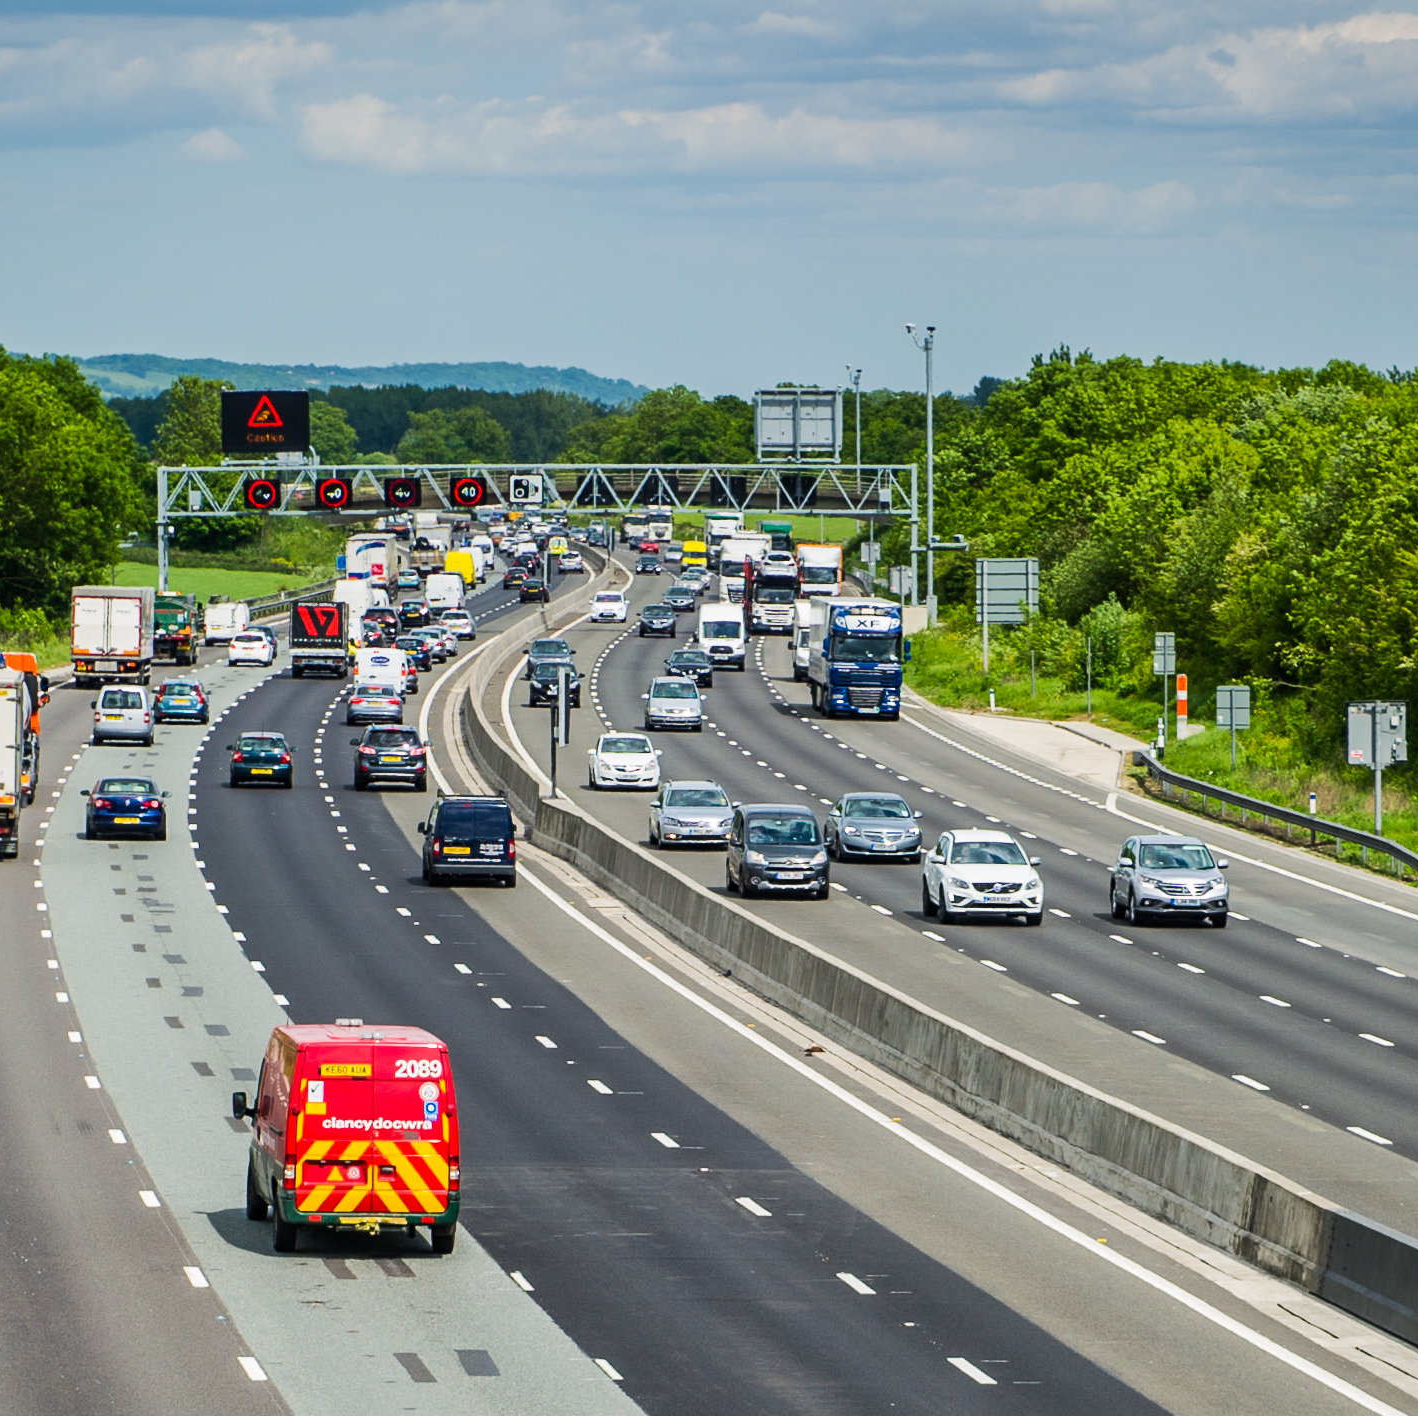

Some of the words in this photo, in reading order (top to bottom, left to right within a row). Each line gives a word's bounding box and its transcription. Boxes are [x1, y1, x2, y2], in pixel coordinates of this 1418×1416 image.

[461, 487, 476, 498] 40
[856, 619, 880, 628] XF
[394, 1059, 443, 1078] 2089
[322, 1117, 432, 1131] clancydocwra
